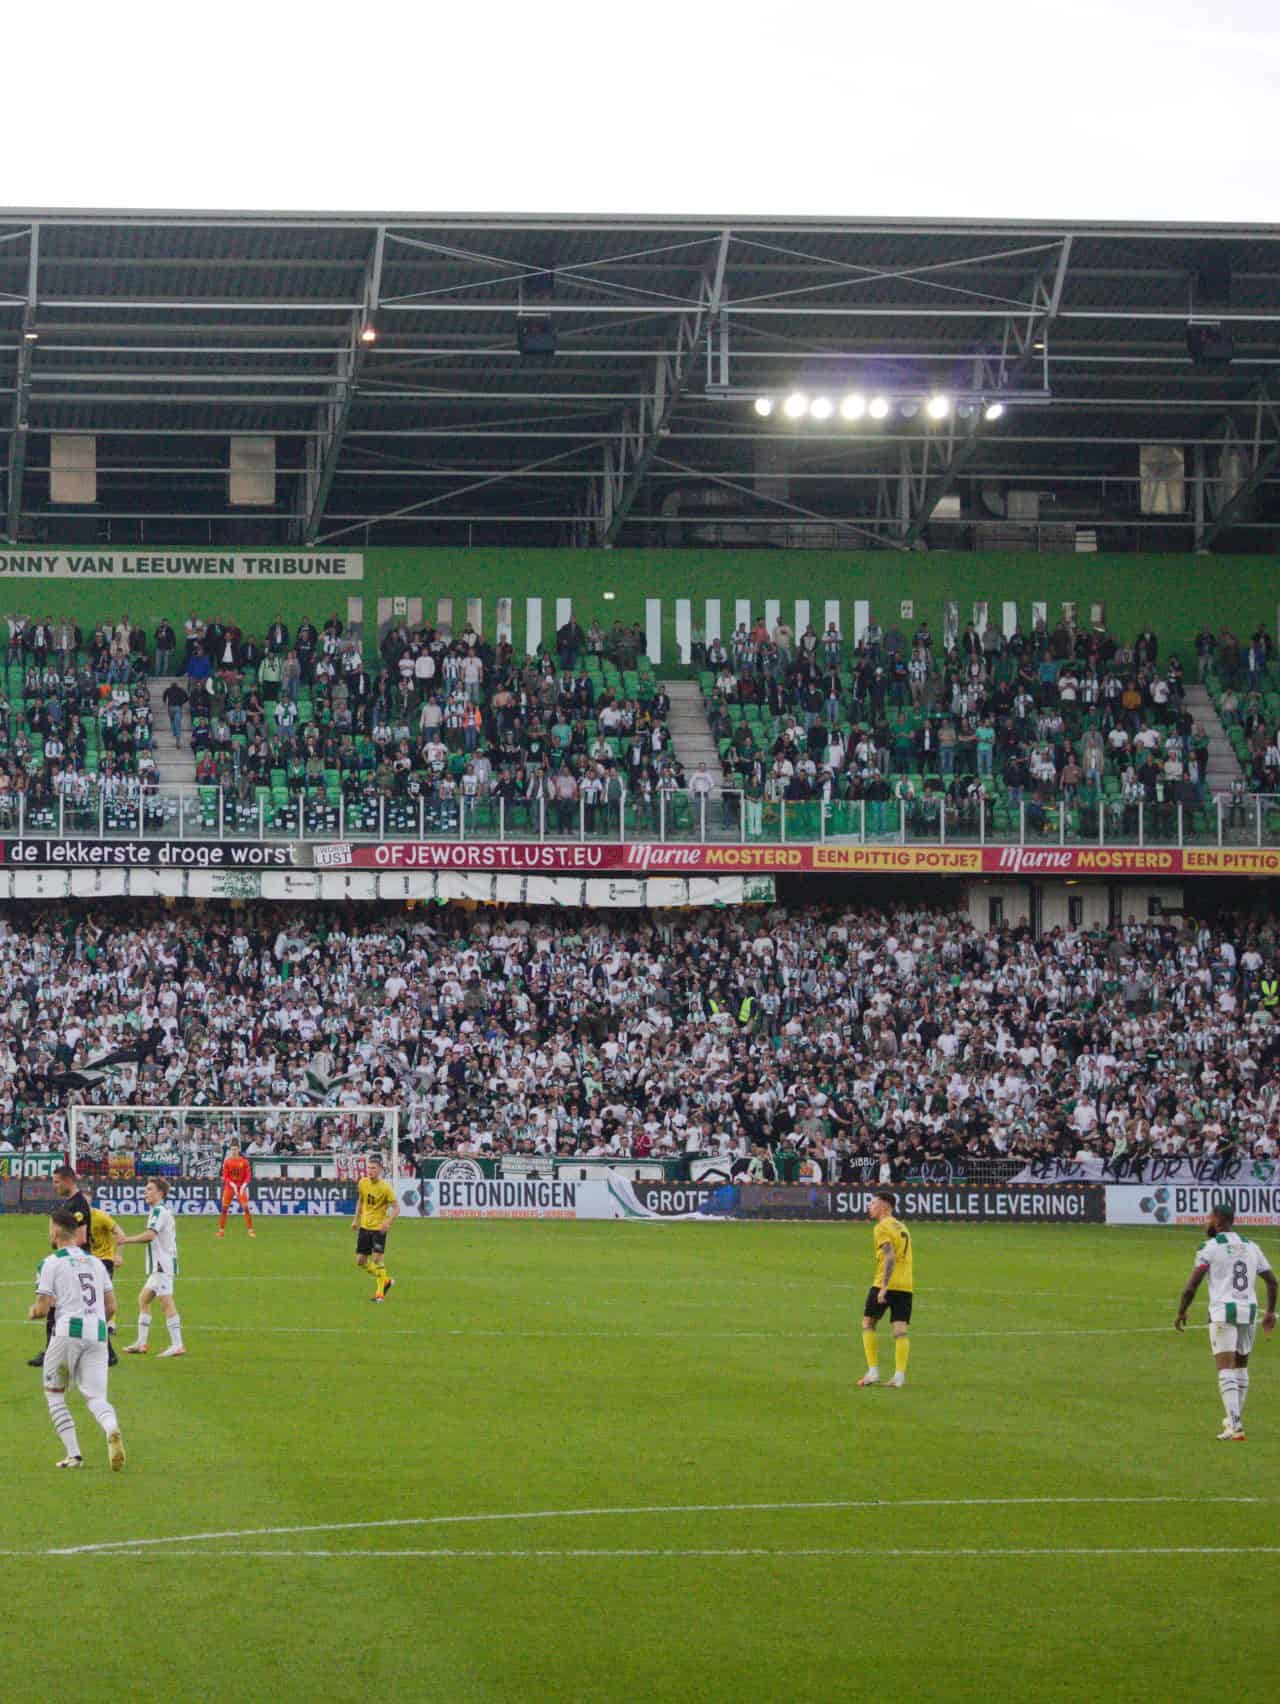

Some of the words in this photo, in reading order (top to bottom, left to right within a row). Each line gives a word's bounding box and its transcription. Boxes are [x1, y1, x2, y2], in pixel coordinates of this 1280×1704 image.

[67, 557, 115, 574] VAN
[121, 557, 235, 574] LEEUWEN
[245, 558, 347, 575] TRIBUNE
[11, 841, 38, 863] de
[45, 841, 151, 863] lekkerste
[158, 842, 223, 867] droge
[231, 843, 298, 865] worst
[315, 851, 350, 866] LUST
[375, 845, 603, 866] OFJEWORSTLUST.EU
[627, 843, 701, 870] Marne
[706, 849, 802, 865] MOSTERD
[816, 850, 850, 865] EEN
[853, 850, 911, 866] PITTIG
[915, 851, 978, 867] POTJE?
[999, 847, 1073, 873] Marne
[1077, 851, 1173, 868] MOSTERD
[1187, 853, 1219, 867] EEN
[1222, 853, 1279, 867] PITTIG
[439, 1181, 577, 1207] BETONDINGEN
[905, 1193, 978, 1214] SNELLE
[984, 1193, 1086, 1216] LEVERING!
[901, 1231, 909, 1257] 7
[1232, 1261, 1248, 1292] 8
[78, 1273, 97, 1307] 5
